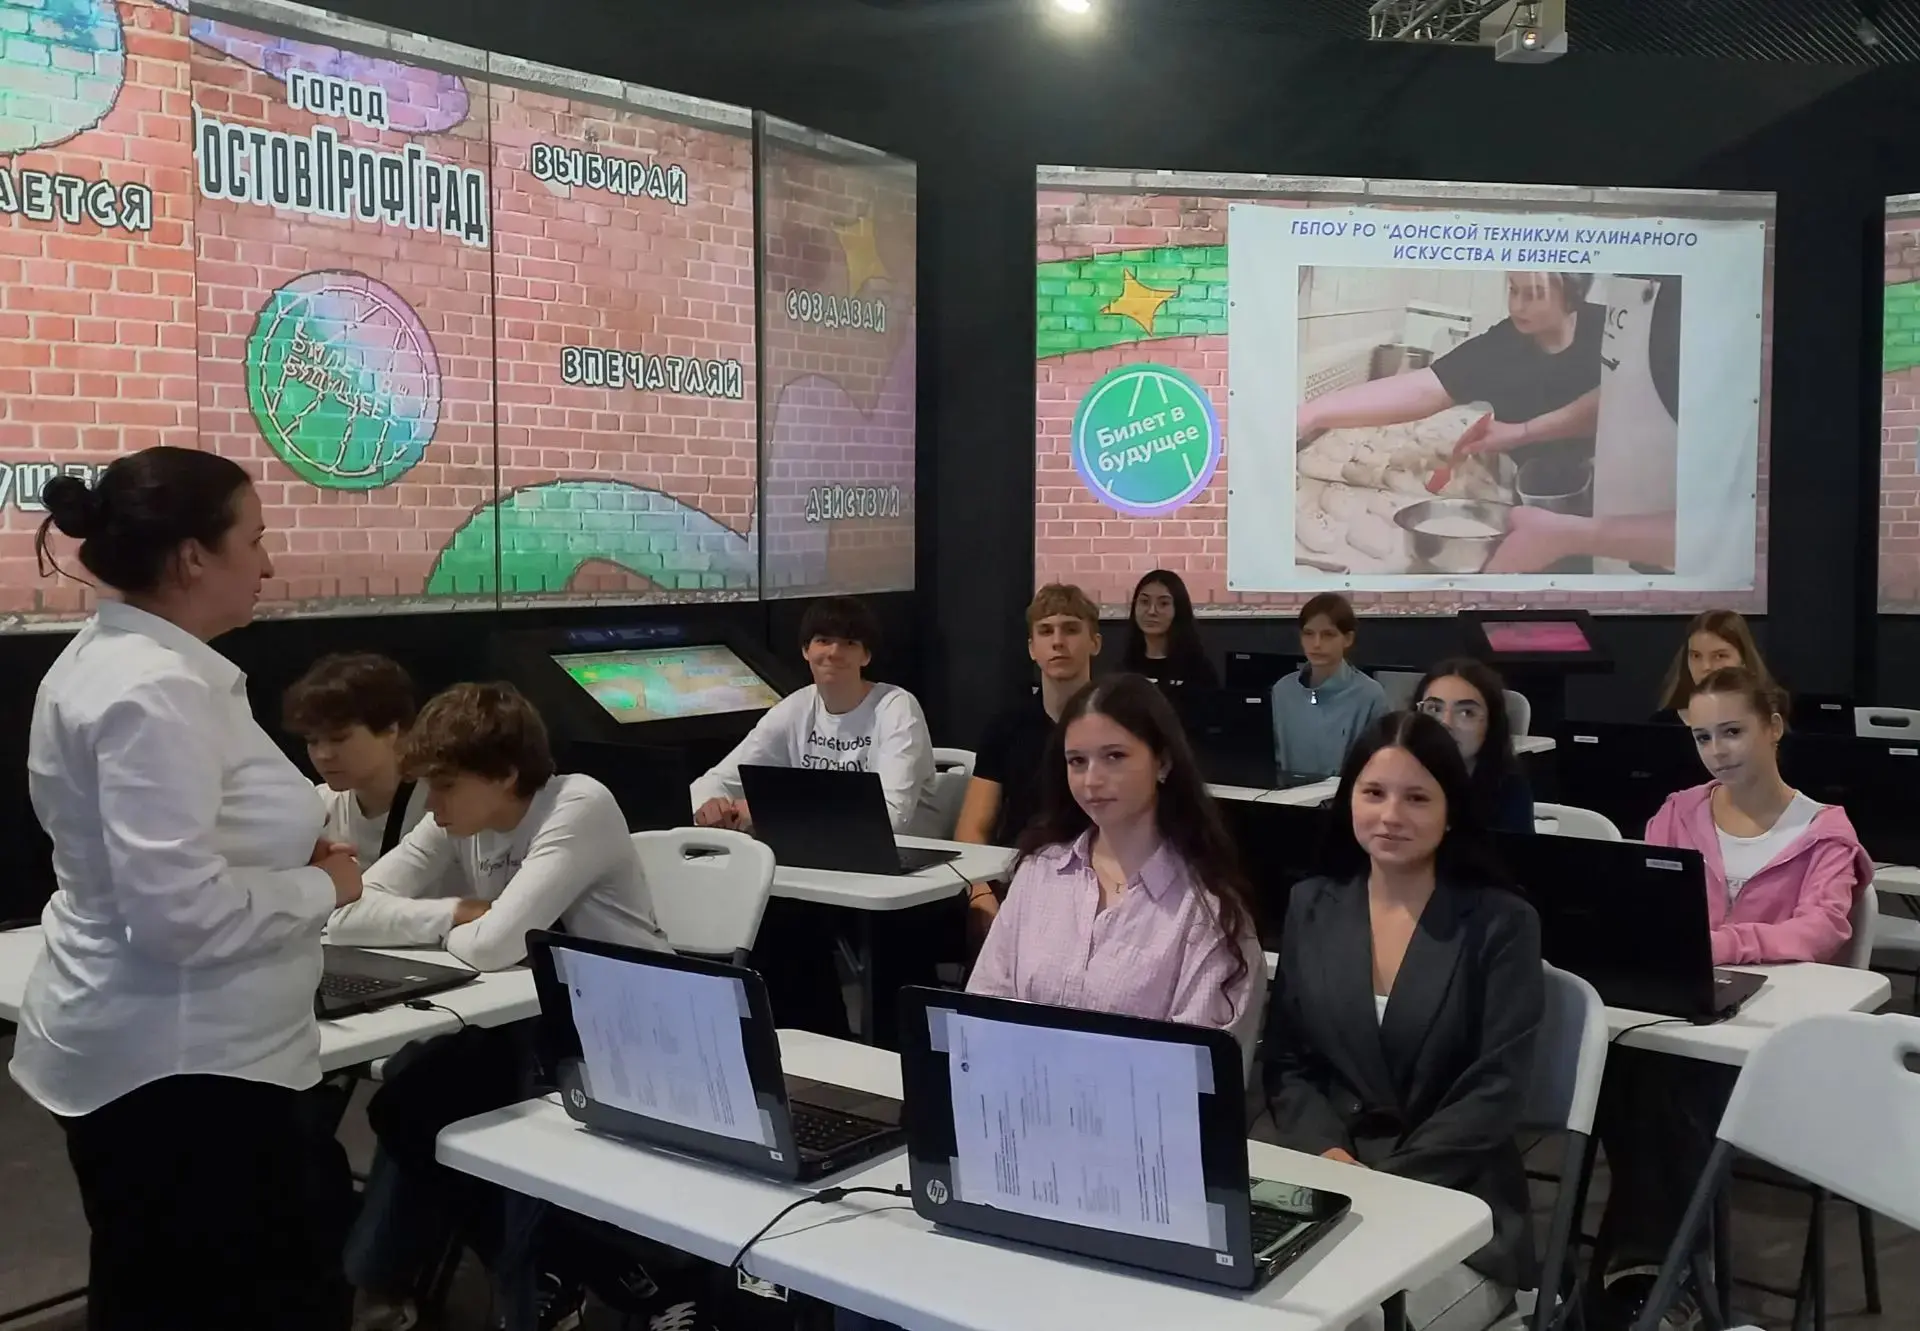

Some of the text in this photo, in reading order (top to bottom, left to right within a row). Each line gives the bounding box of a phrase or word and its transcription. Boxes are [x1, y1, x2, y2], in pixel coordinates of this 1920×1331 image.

[289, 71, 387, 128] ГОРОД
[532, 143, 687, 206] ВЫБИРАЙ
[1291, 221, 1348, 236] ГБПОУ
[1352, 223, 1376, 237] РО
[1483, 226, 1569, 244] ТЕХНИКУМ
[1575, 229, 1698, 247] КУЛИНАРНОГО
[1393, 245, 1495, 261] ИСКУССТВА
[1501, 248, 1511, 262] И
[786, 288, 886, 333] СОЗДАВАЙ
[561, 346, 744, 399] ВПЕЧАТЛЯЙ
[1096, 406, 1186, 448] Билет в
[1097, 425, 1200, 473] будущее
[805, 483, 900, 523] ДЕЙСТВУЙ
[572, 1088, 585, 1108] hp
[929, 1179, 946, 1205] hp
